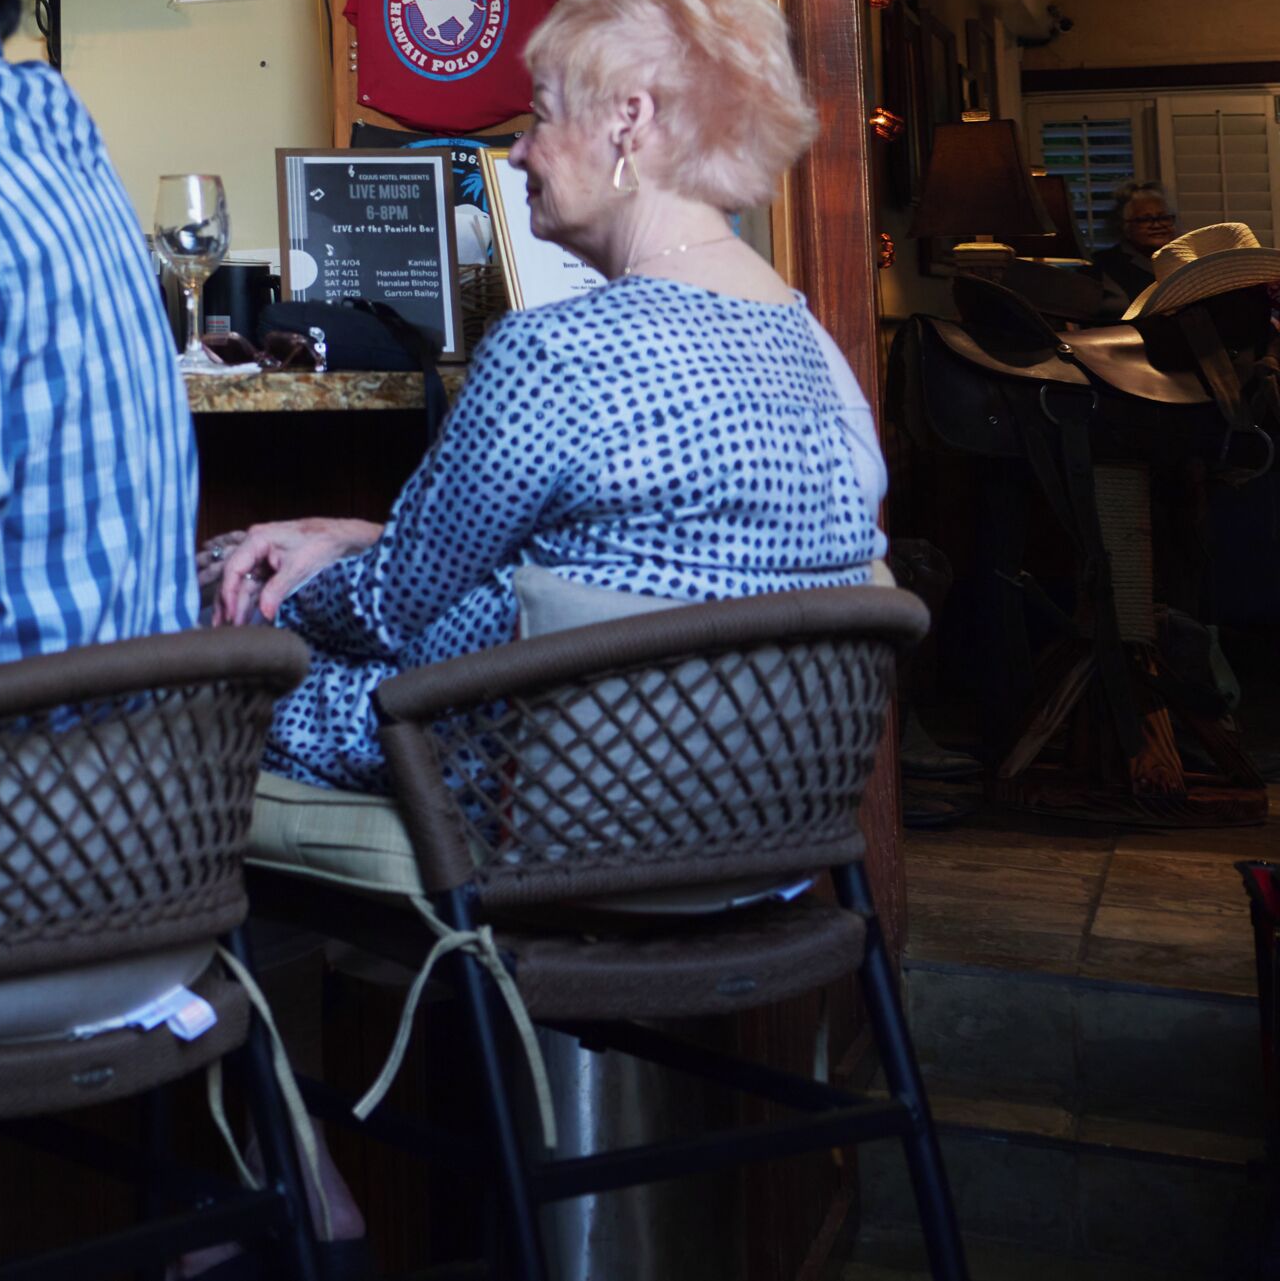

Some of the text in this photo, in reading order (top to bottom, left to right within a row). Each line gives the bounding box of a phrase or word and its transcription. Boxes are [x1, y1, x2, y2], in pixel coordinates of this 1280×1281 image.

[390, 0, 501, 72] HAWAII POLO CLUB
[451, 152, 480, 166] 196
[349, 184, 420, 199] LIVE MUSIC
[366, 205, 408, 220] 6-8PM
[332, 225, 434, 233] LIVE at the Paniolo Bar
[411, 269, 438, 277] Bishop
[411, 280, 439, 288] Bishop
[414, 290, 439, 299] Bailey
